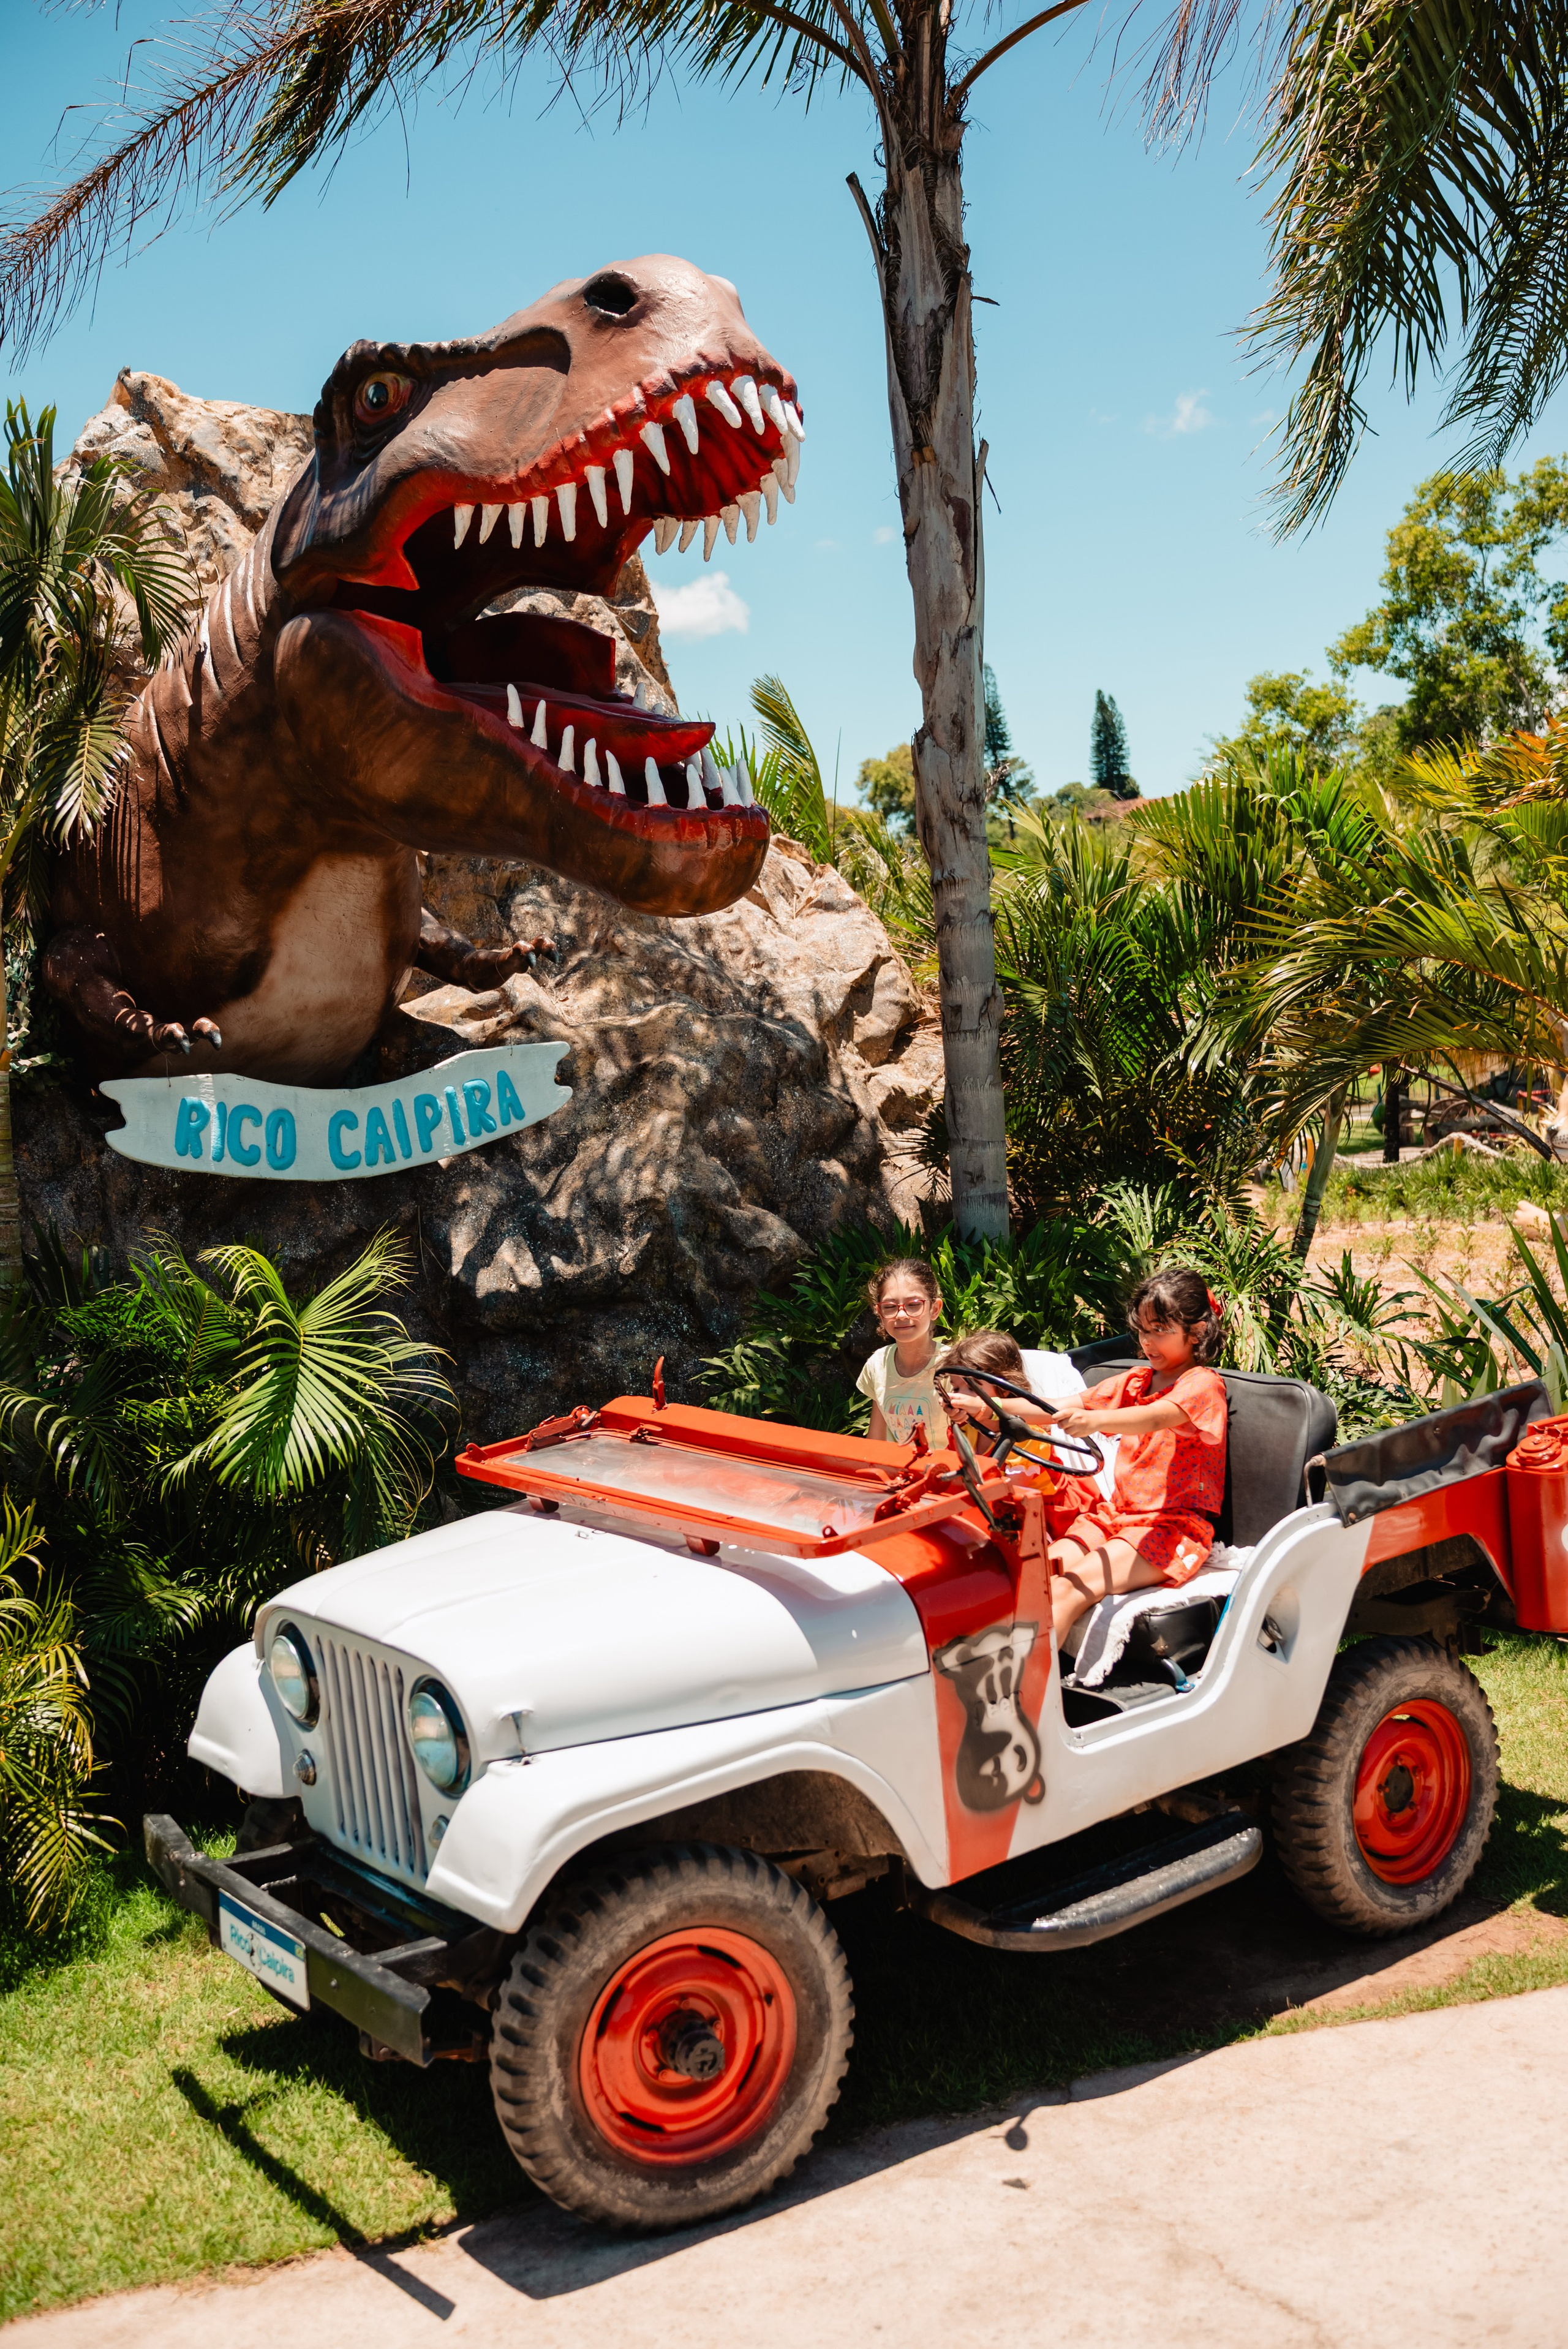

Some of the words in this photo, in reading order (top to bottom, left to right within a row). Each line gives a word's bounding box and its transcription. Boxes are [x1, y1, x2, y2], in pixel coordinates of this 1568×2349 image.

[175, 1096, 297, 1171] RICO
[328, 1070, 526, 1170] CAIPIRA
[230, 1923, 252, 1954] Rico
[257, 1945, 295, 1983] Caipira
